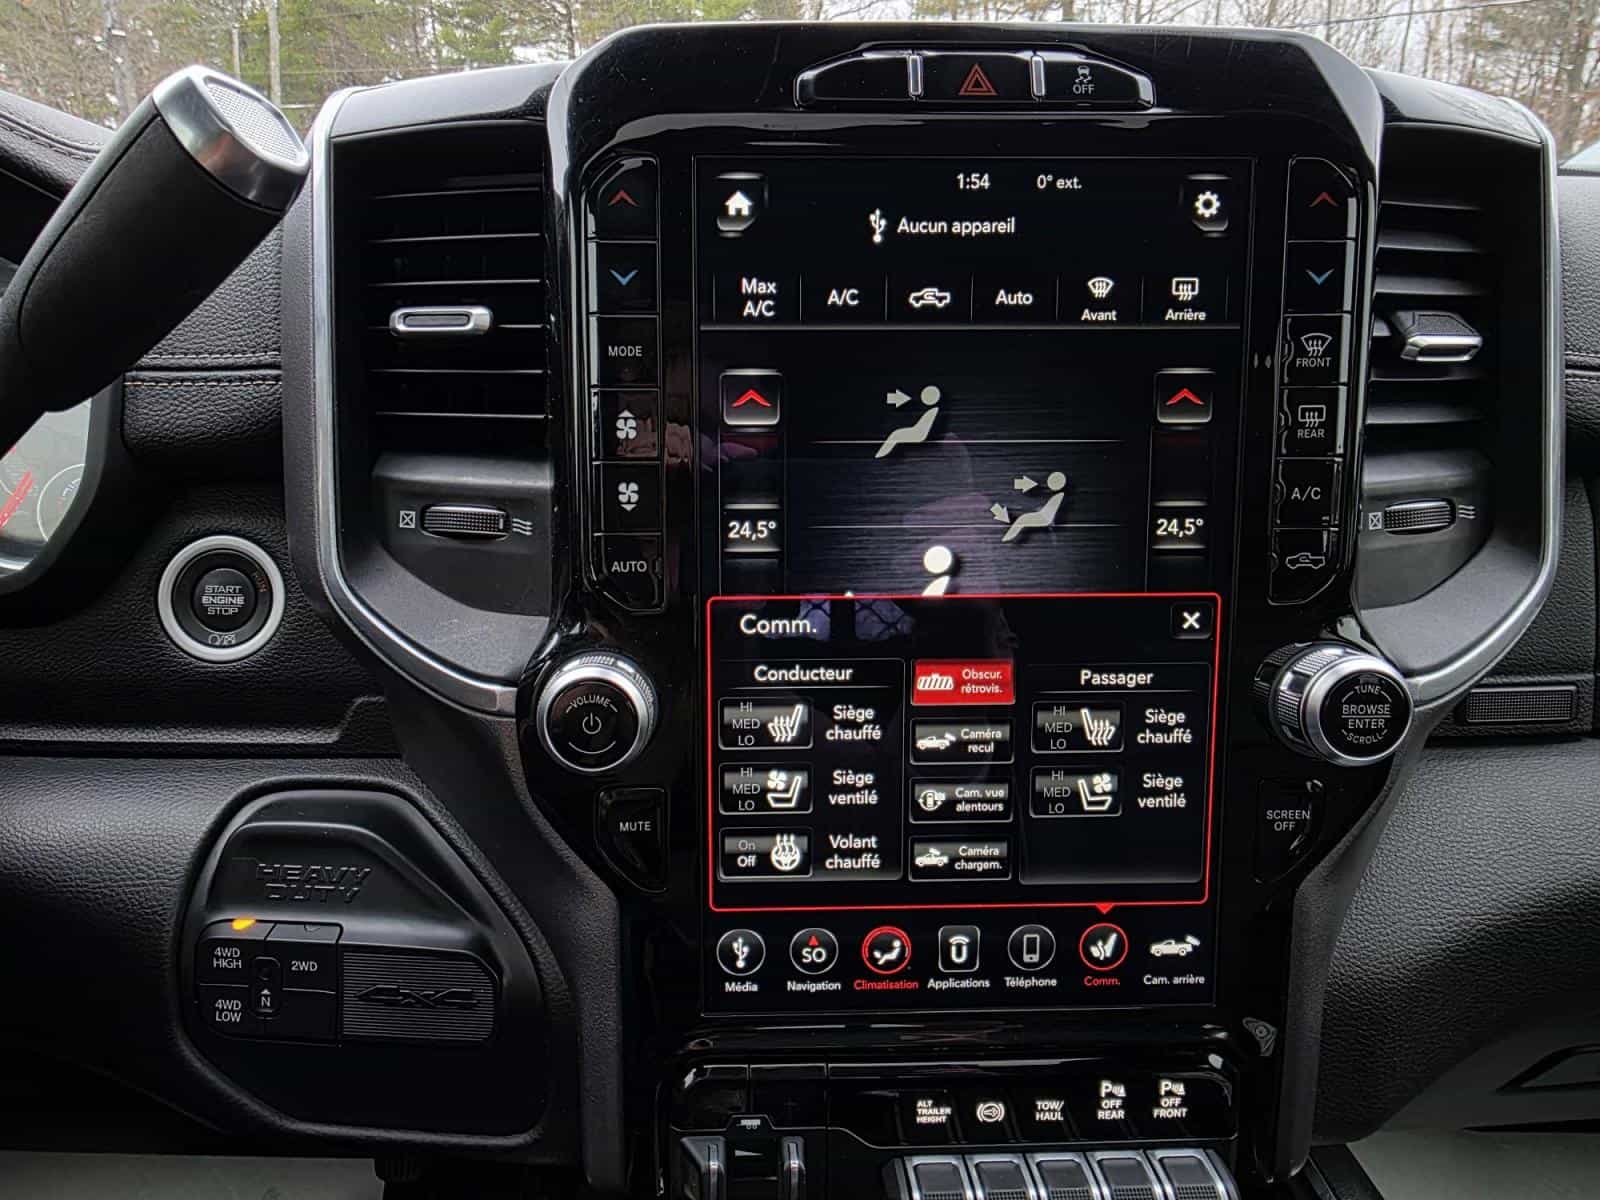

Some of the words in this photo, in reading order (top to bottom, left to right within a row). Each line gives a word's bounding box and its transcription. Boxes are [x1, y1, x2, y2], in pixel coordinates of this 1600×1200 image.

[1072, 81, 1095, 95] OFF
[956, 173, 991, 190] 1:54
[1055, 176, 1083, 190] ext.
[896, 216, 948, 234] Aucun
[951, 216, 1016, 237] appareil
[741, 277, 777, 295] Max
[827, 288, 859, 306] A/C
[995, 289, 1033, 305] Auto
[743, 299, 775, 317] A/C
[1080, 308, 1117, 321] Avant
[1164, 308, 1207, 321] Arrière
[608, 345, 643, 357] MODE
[1295, 356, 1332, 368] FRONT
[1297, 428, 1325, 439] REAR
[1290, 485, 1321, 502] A/C
[727, 520, 777, 542] 24,5°
[1156, 518, 1204, 538] 24,5°
[611, 560, 648, 573] AUTO
[205, 585, 241, 593] START
[202, 596, 244, 604] ENGINE
[208, 606, 239, 615] STOP
[739, 615, 818, 635] Comm.
[753, 664, 854, 682] Conducteur
[961, 667, 1004, 681] Obscur.
[1080, 669, 1154, 688] Passager
[960, 682, 1004, 695] rétrovis.
[1354, 684, 1382, 695] TUNE
[569, 694, 612, 710] VOLUME
[739, 702, 754, 713] HI
[833, 704, 875, 723] Siège
[1052, 706, 1069, 717] HI
[1342, 703, 1391, 715] BROWSE
[731, 717, 761, 728] MED
[1144, 708, 1186, 727] Siège
[1348, 718, 1385, 729] ENTER
[1044, 720, 1074, 732] MED
[825, 724, 882, 741] chauffé
[960, 727, 1003, 740] Caméra
[1136, 727, 1193, 744] chauffé
[1345, 732, 1384, 744] SCROLL
[736, 735, 756, 748] LO
[967, 741, 995, 753] recul
[1051, 739, 1068, 751] LO
[739, 768, 754, 778] HI
[832, 769, 875, 788] Siège
[1050, 771, 1067, 782] HI
[731, 781, 761, 794] MED
[1142, 772, 1184, 791] Siège
[828, 789, 879, 805] ventilé
[955, 788, 984, 799] Cam.
[1043, 785, 1072, 797] MED
[736, 800, 756, 813] LO
[955, 800, 1004, 812] alentours
[1137, 792, 1187, 809] ventilé
[1046, 803, 1067, 816] LO
[1266, 809, 1311, 820] SCREEN
[619, 820, 651, 832] MUTE
[1273, 820, 1296, 832] OFF
[735, 839, 758, 851] On
[828, 833, 878, 849] Volant
[958, 844, 1001, 857] Caméra
[736, 854, 757, 868] Off
[825, 853, 881, 870] chauffé
[954, 858, 1003, 872] chargem.
[213, 946, 241, 958] 4WD
[801, 947, 827, 963] SO
[212, 957, 242, 969] HIGH
[291, 960, 318, 972] 2WD
[853, 979, 919, 991] Climatisation
[927, 977, 991, 991] Applications
[1003, 976, 1058, 989] Téléphone
[1083, 975, 1121, 987] Comm.
[1143, 974, 1170, 985] Cam.
[1172, 973, 1206, 985] arrière
[724, 981, 759, 993] Média
[786, 980, 842, 993] Navigation
[215, 999, 242, 1011] 4WD
[260, 996, 271, 1007] N
[215, 1010, 242, 1023] LOW
[916, 1099, 933, 1108] ALT
[1035, 1100, 1065, 1112] TOW/
[1101, 1098, 1123, 1110] OFF
[1160, 1097, 1182, 1108] OFF
[916, 1107, 951, 1116] TRAILER
[1035, 1109, 1064, 1121] HAUL
[1097, 1109, 1125, 1120] REAR
[1153, 1107, 1188, 1119] FRONT
[916, 1114, 947, 1124] HEIGHT
